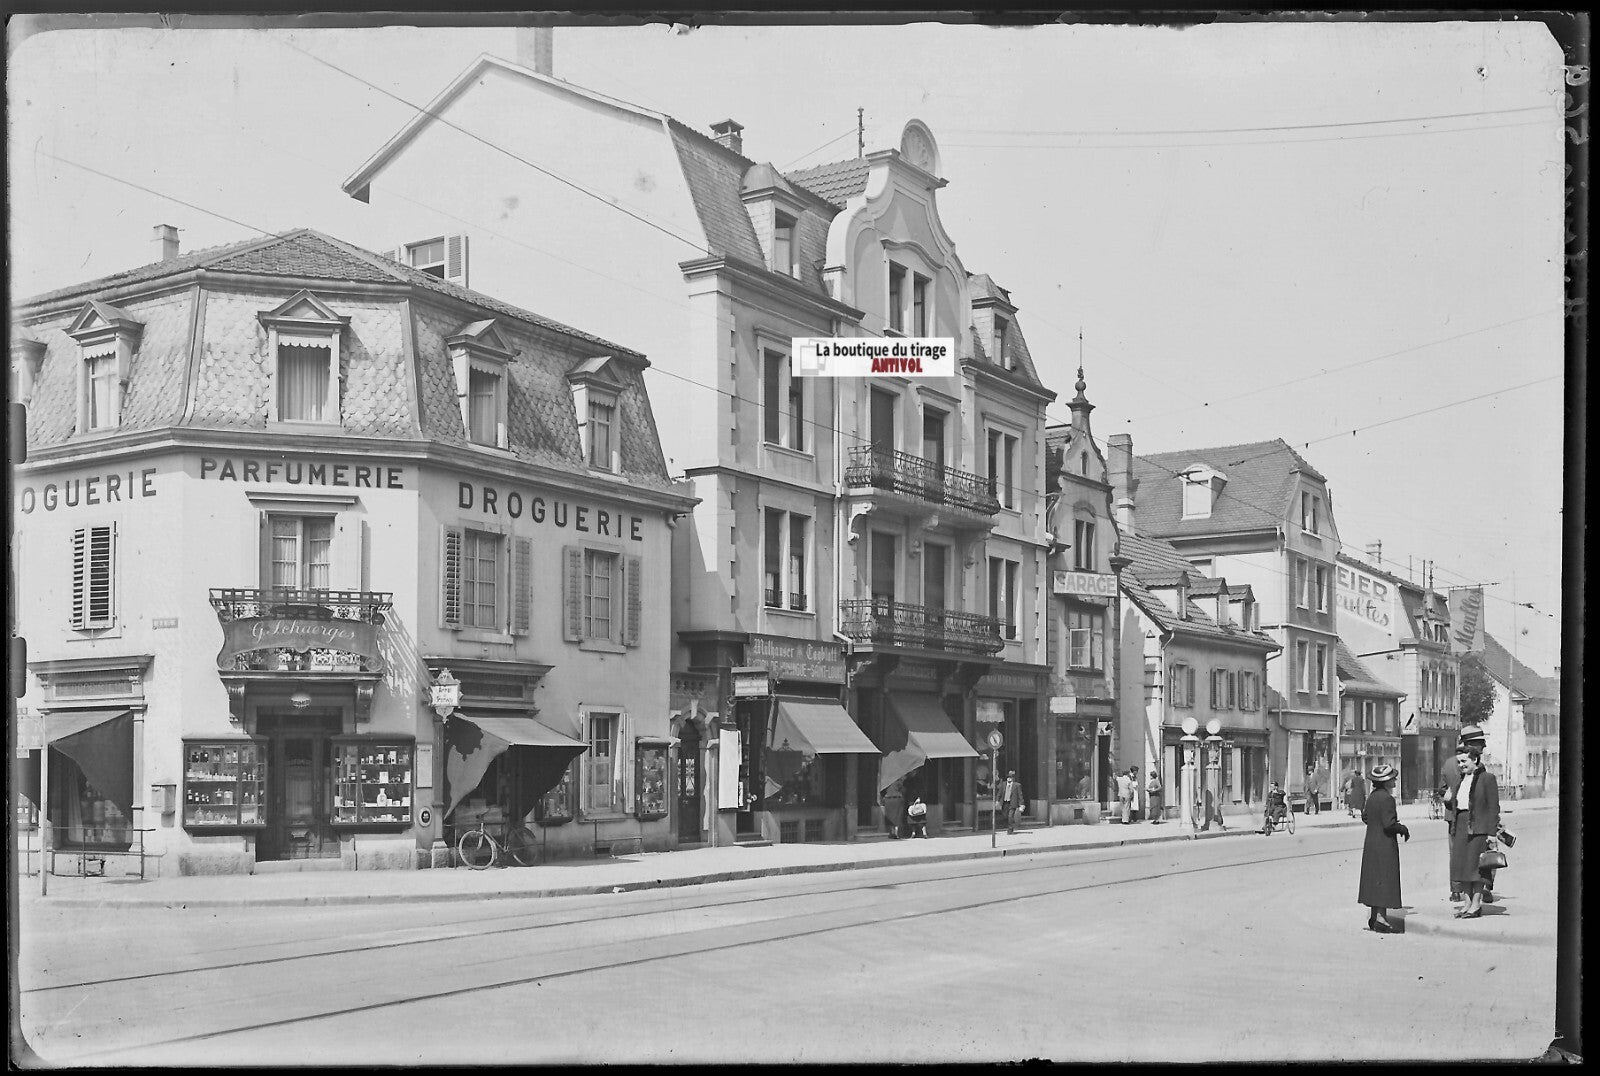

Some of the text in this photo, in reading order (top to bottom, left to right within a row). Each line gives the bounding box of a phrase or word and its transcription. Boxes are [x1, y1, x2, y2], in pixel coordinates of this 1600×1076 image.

[201, 457, 404, 489] PARFUMERIE
[458, 481, 643, 541] DROGUERIE
[1056, 573, 1117, 594] GARAGE
[1454, 587, 1483, 650] Meubles
